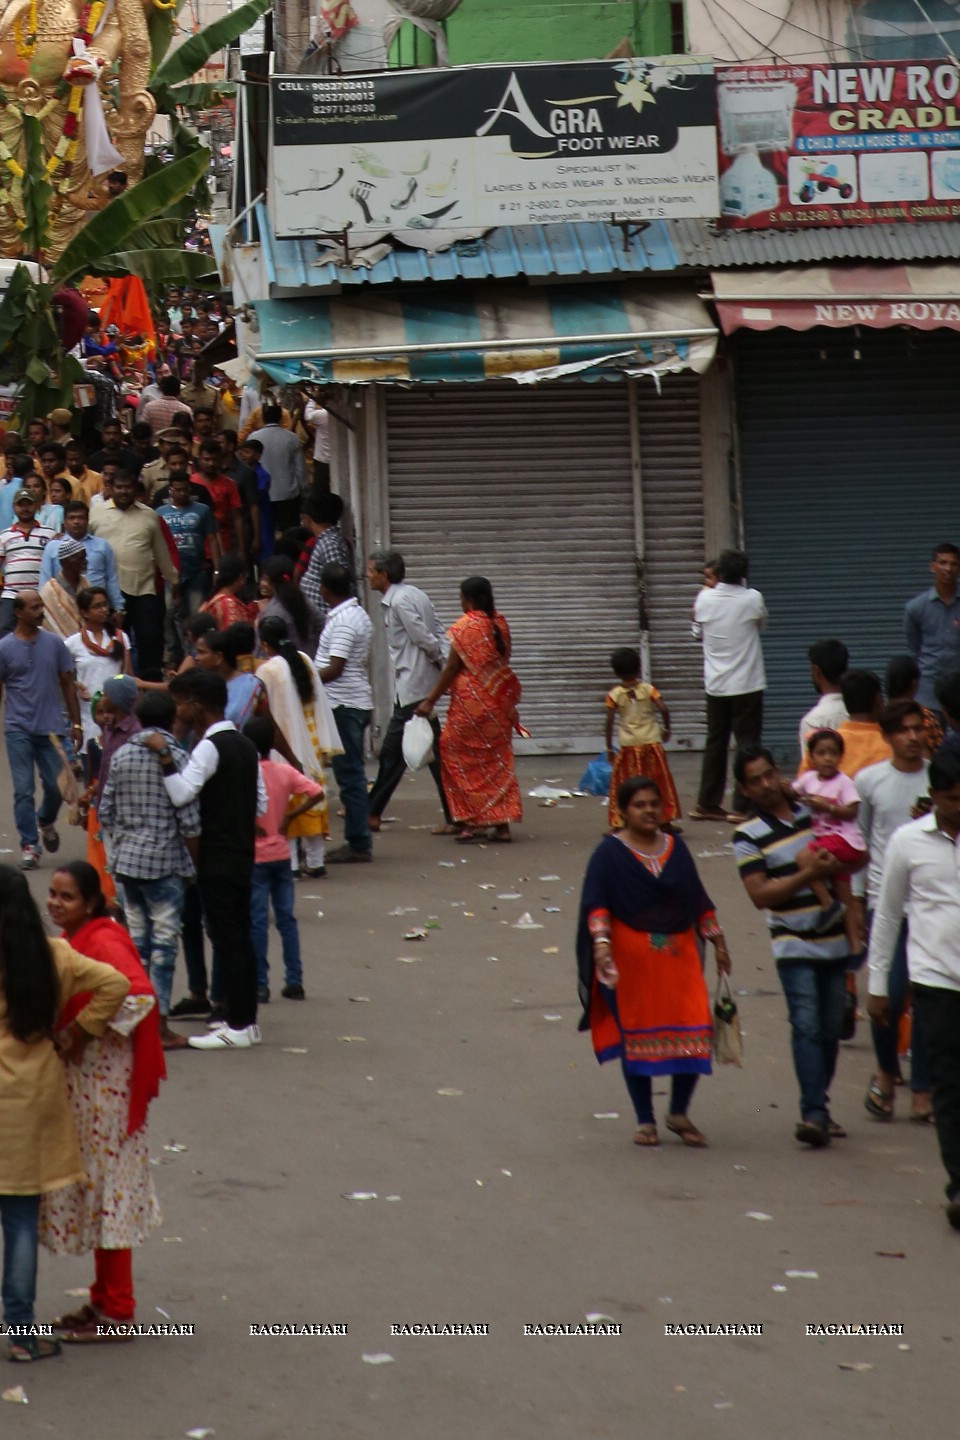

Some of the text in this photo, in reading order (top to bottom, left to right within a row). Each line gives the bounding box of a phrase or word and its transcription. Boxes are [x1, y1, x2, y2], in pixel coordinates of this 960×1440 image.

[278, 82, 304, 91] CELL
[812, 64, 960, 104] NEW RO
[476, 71, 604, 138] AGRA
[558, 134, 660, 151] FOOT WEAR
[528, 182, 537, 191] &
[573, 178, 604, 188] WEAR
[614, 177, 623, 186] &
[683, 173, 716, 183] WEAR
[815, 302, 960, 321] NEW ROYA
